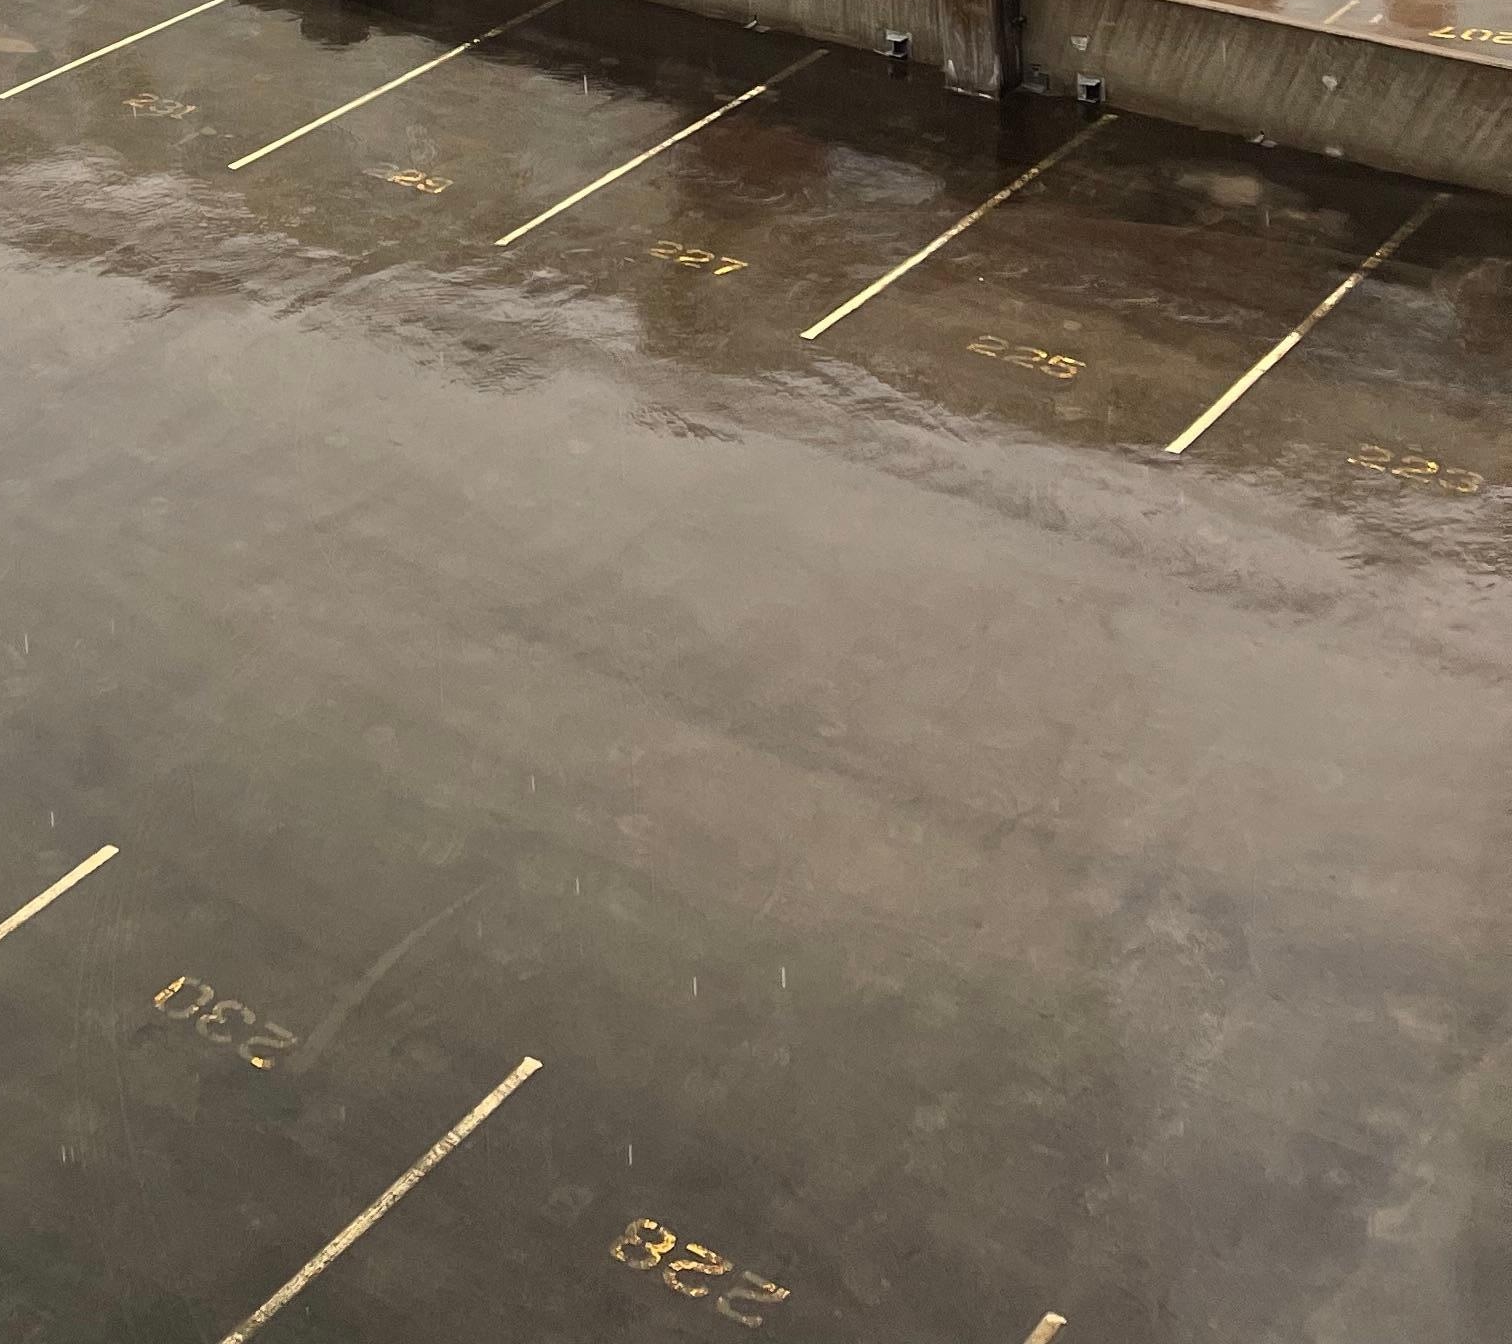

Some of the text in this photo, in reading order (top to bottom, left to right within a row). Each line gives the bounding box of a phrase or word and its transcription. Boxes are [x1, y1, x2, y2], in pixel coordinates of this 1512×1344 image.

[648, 239, 749, 275] 227
[966, 335, 1087, 379] 225
[1346, 443, 1485, 493] 223
[153, 975, 297, 1070] 230
[609, 1216, 791, 1329] 228
